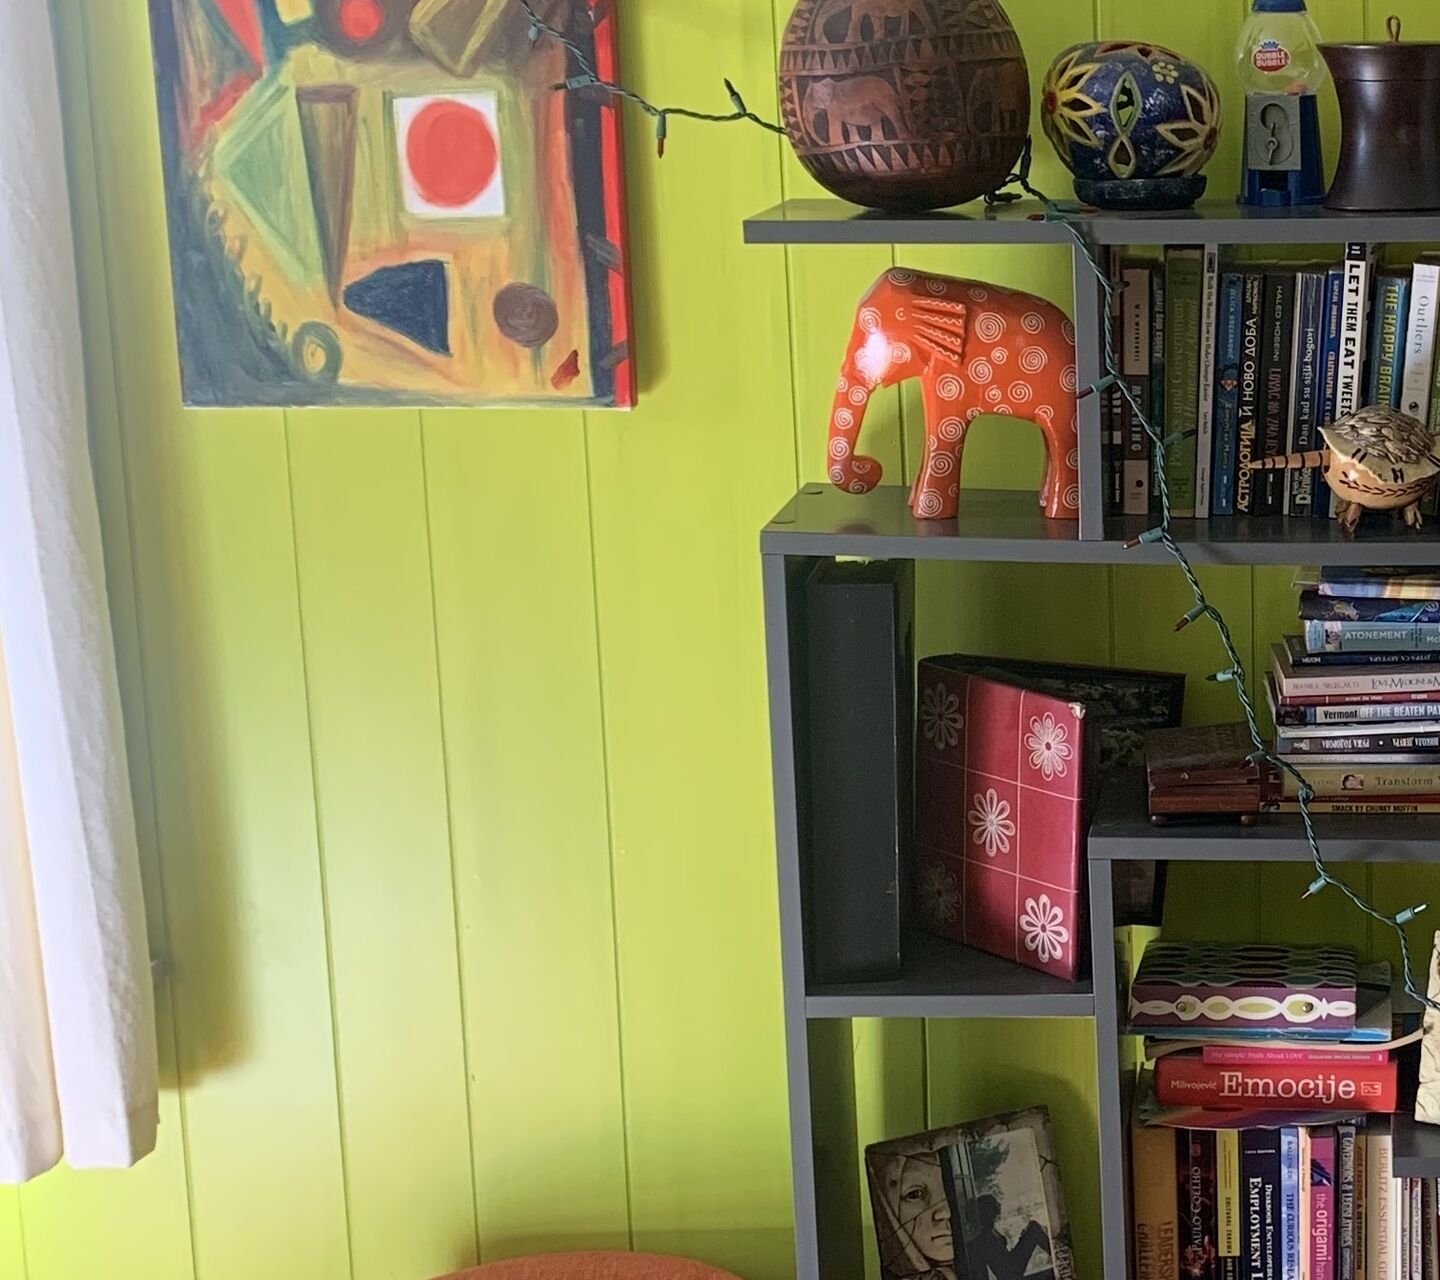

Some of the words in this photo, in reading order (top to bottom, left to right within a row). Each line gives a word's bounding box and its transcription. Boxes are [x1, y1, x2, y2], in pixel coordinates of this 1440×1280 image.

[1348, 265, 1360, 296] LET
[1387, 285, 1399, 311] THE
[1346, 302, 1358, 332] THEM
[1413, 295, 1430, 354] Outliers
[1343, 337, 1356, 369] EAT
[1381, 314, 1396, 361] HAPPY
[1340, 375, 1354, 417] TWEETS
[1376, 366, 1392, 408] BRAIN
[1344, 629, 1408, 641] ATONEMENT
[1323, 709, 1358, 720] Vermont
[1360, 708, 1375, 719] OFF
[1376, 707, 1391, 718] THE
[1393, 705, 1425, 718] BEATEN
[1375, 775, 1434, 788] Transform
[1170, 1078, 1217, 1091] Milivojević
[1219, 1071, 1356, 1104] Emocije
[1342, 1137, 1354, 1182] GOVERNORS
[1378, 1148, 1388, 1193] BERLITZ
[1191, 1166, 1201, 1212] COELHO
[1264, 1184, 1274, 1224] DESKBOOK
[1286, 1193, 1295, 1211] THE
[1315, 1194, 1326, 1208] the
[1191, 1219, 1202, 1251] PAULO
[1249, 1177, 1262, 1268] EMPLOYMENT
[1286, 1212, 1295, 1251] CURIOUS
[1311, 1210, 1331, 1261] origami
[1341, 1193, 1353, 1246] LEGISLATURES
[1378, 1194, 1388, 1255] ESSENTIAL
[1265, 1225, 1274, 1280] ENCYCLOPEDIA
